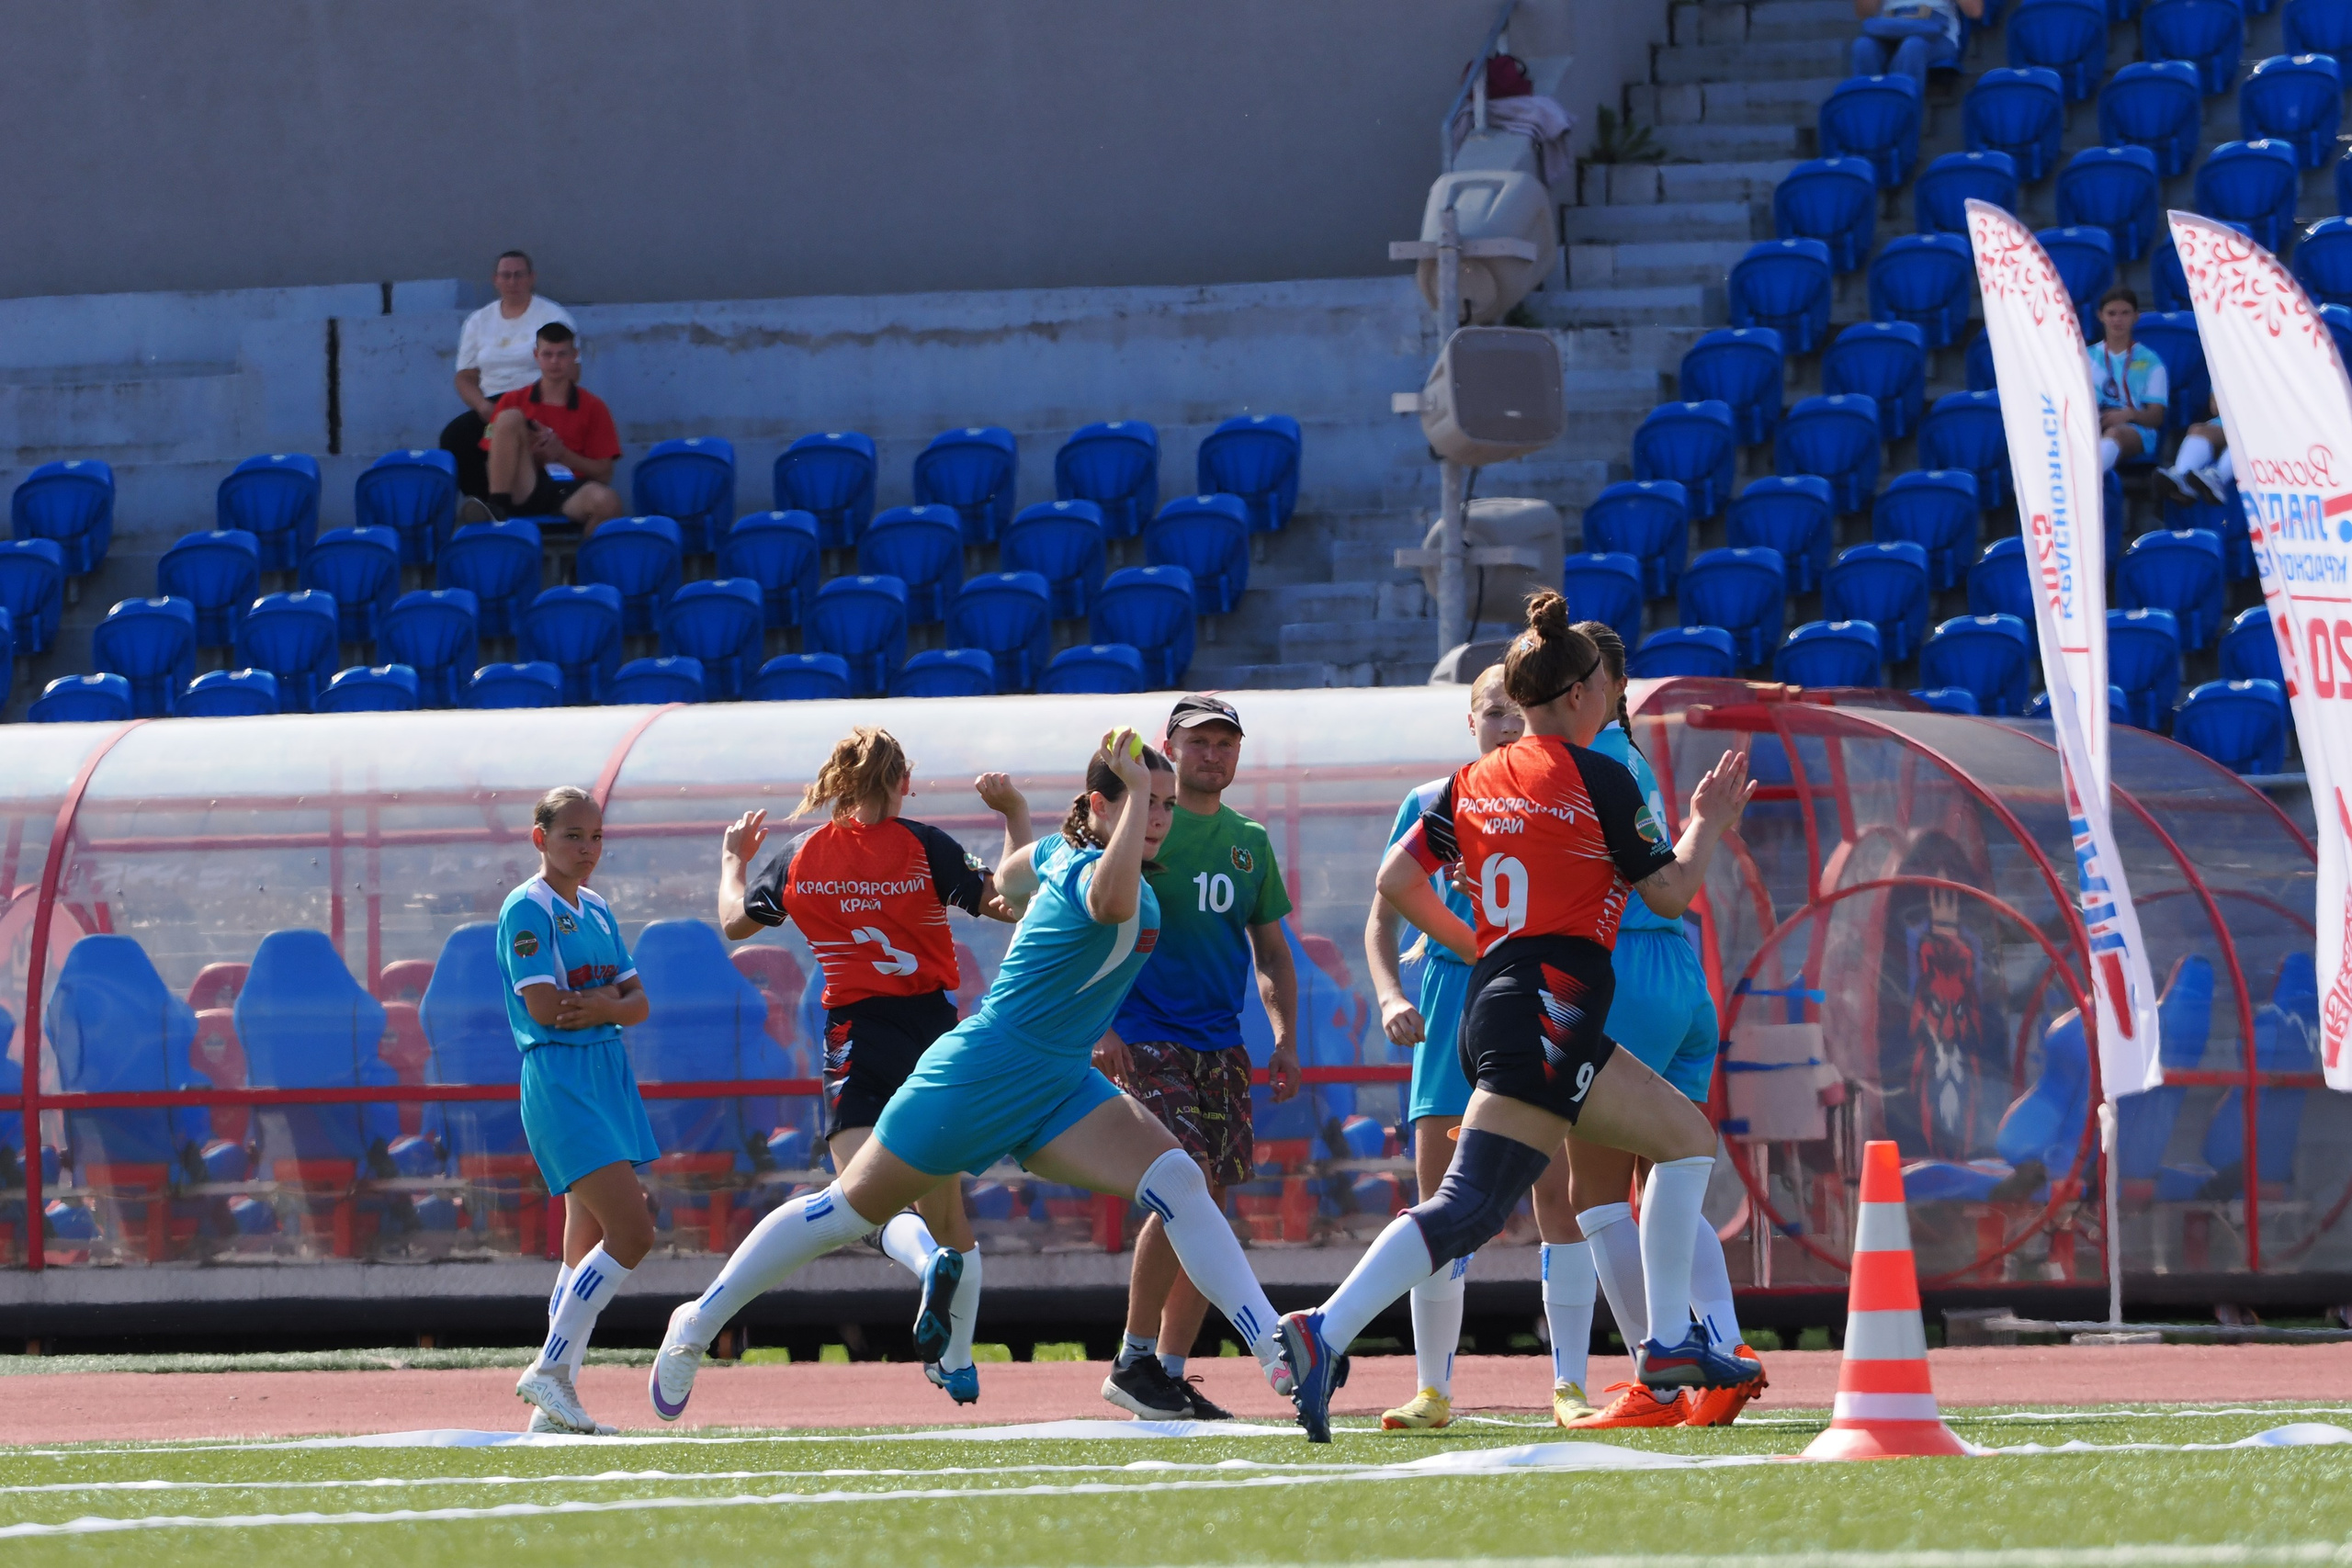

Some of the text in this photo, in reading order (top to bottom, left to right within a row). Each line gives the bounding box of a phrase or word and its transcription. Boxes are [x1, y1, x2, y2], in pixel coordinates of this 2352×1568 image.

[1482, 816, 1524, 835] КРАЙ
[796, 875, 925, 896] КРАСНОЯРСКИЙ
[840, 897, 882, 913] КРАЙ
[1193, 871, 1235, 913] 10
[1480, 852, 1529, 958] 9
[851, 926, 919, 976] 3
[1569, 1061, 1595, 1102] 9
